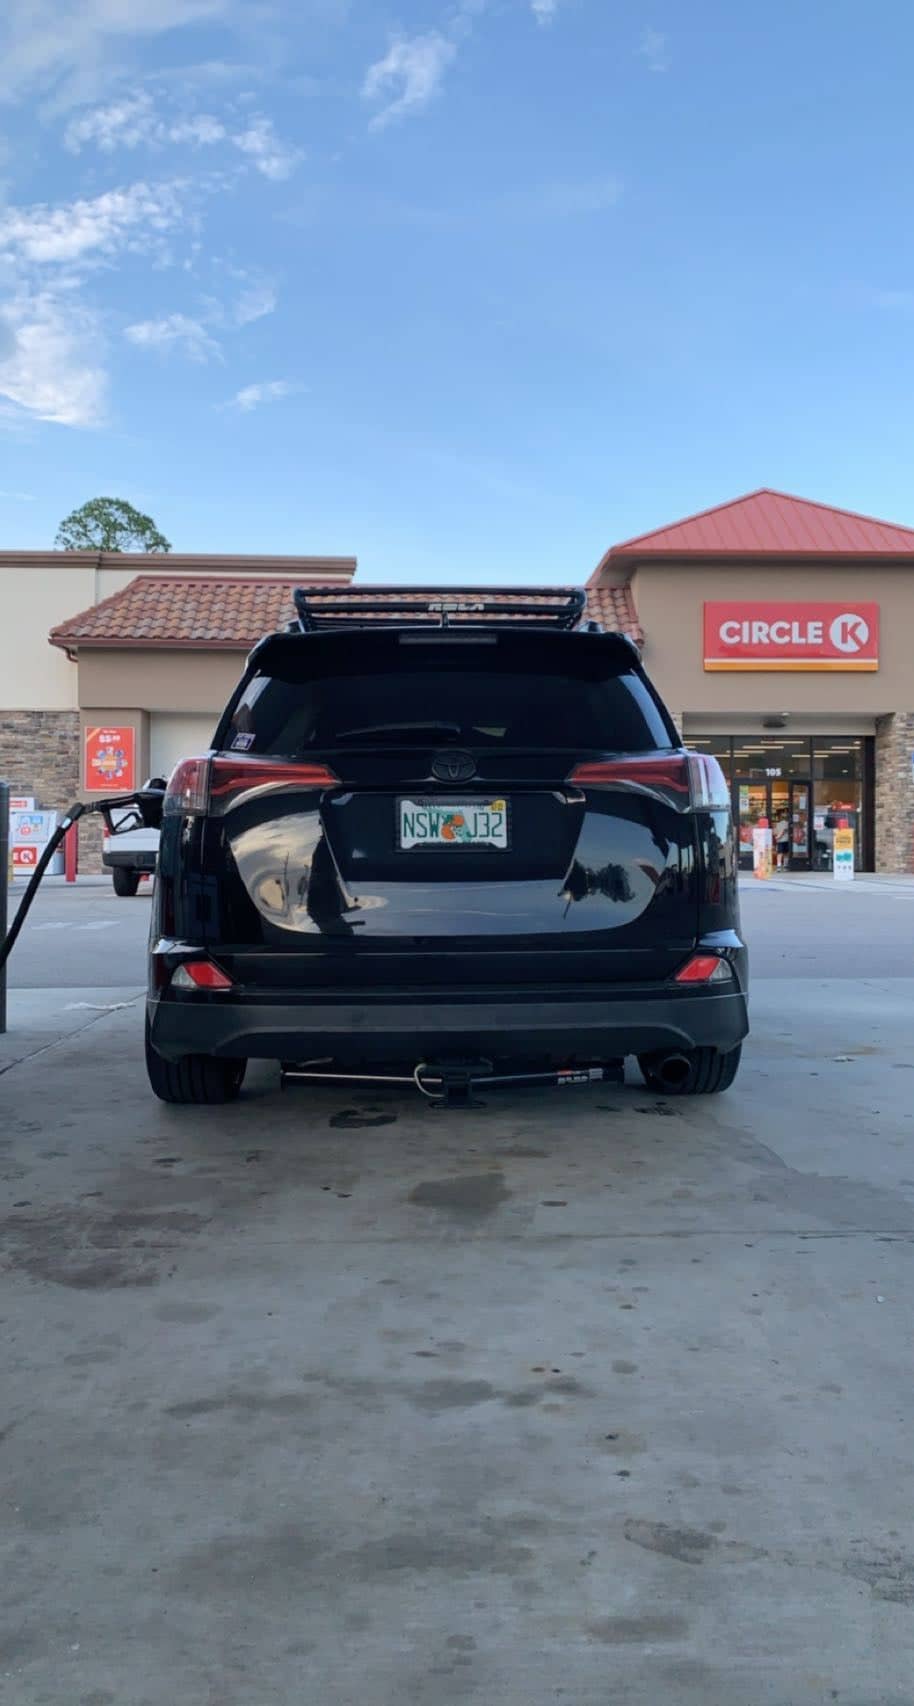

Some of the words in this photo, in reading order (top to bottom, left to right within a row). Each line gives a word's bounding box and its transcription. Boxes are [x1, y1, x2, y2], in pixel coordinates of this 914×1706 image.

[719, 620, 823, 644] CIRCLE
[837, 619, 868, 650] K
[765, 768, 782, 777] 105
[403, 812, 439, 838] NSW
[466, 812, 503, 838] J32
